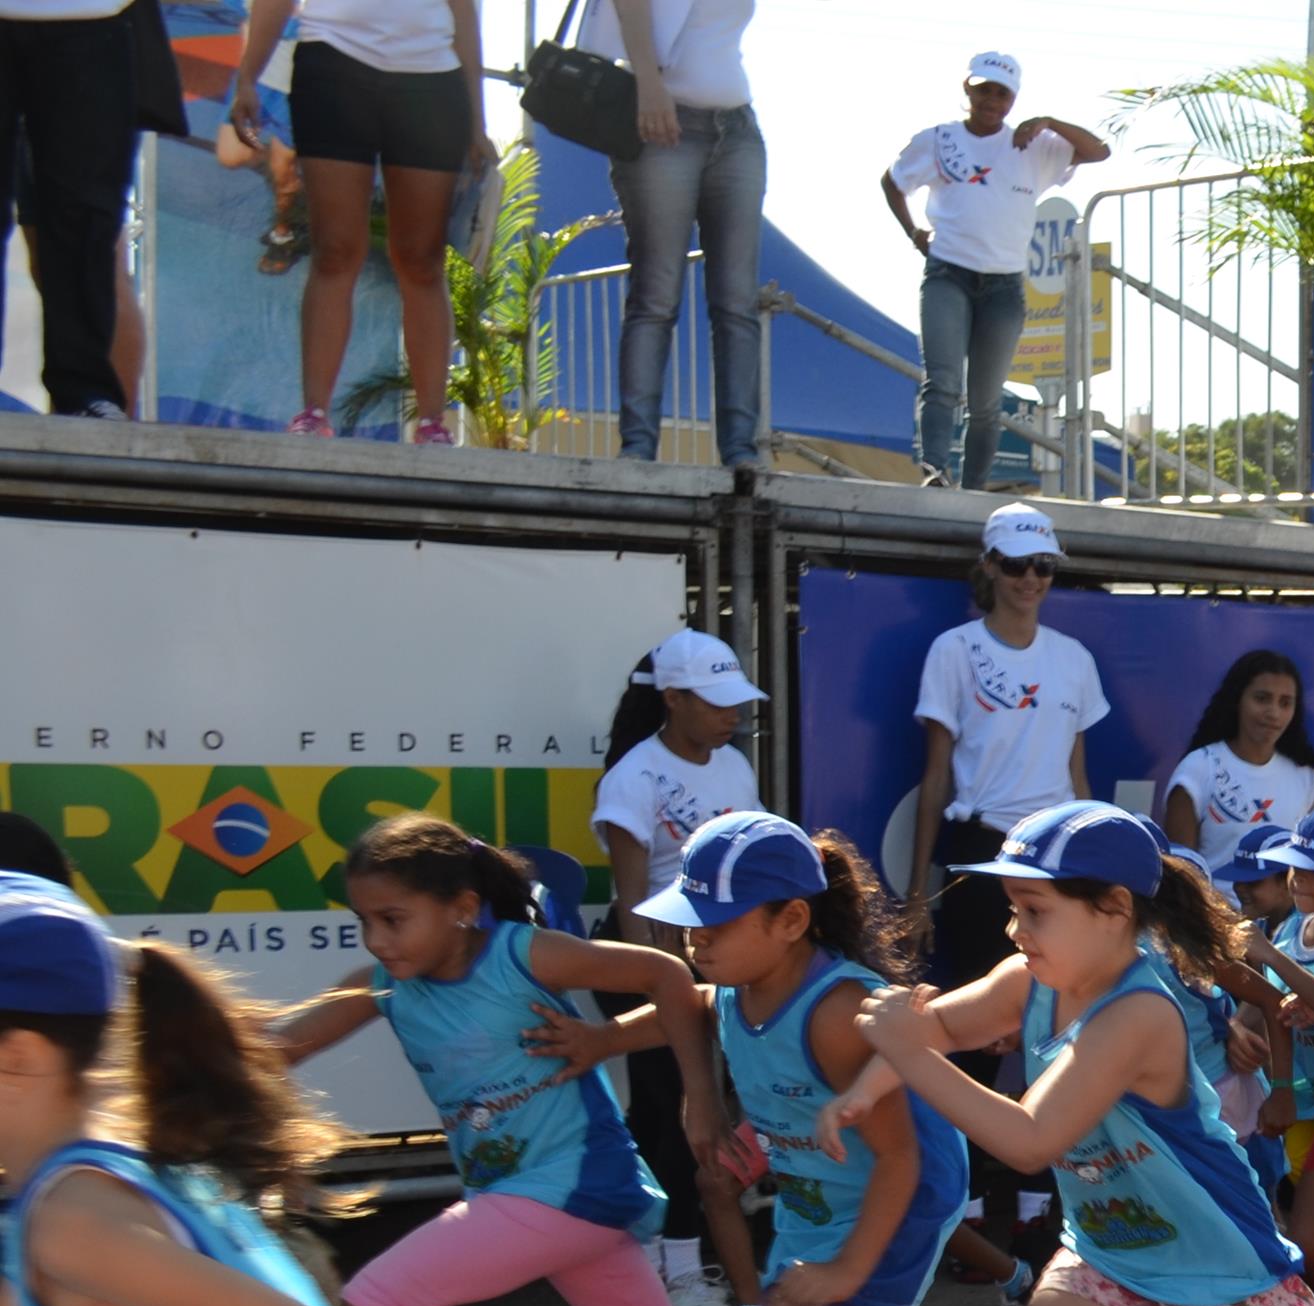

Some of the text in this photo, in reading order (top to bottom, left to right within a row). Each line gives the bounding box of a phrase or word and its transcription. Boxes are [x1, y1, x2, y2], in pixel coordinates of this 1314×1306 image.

[984, 58, 1014, 75] CAIXA
[1015, 523, 1051, 538] CAIXA
[300, 731, 610, 755] FEDERAL
[189, 921, 287, 954] PAÍS
[309, 923, 362, 952] SE
[771, 1083, 814, 1098] CAIXA
